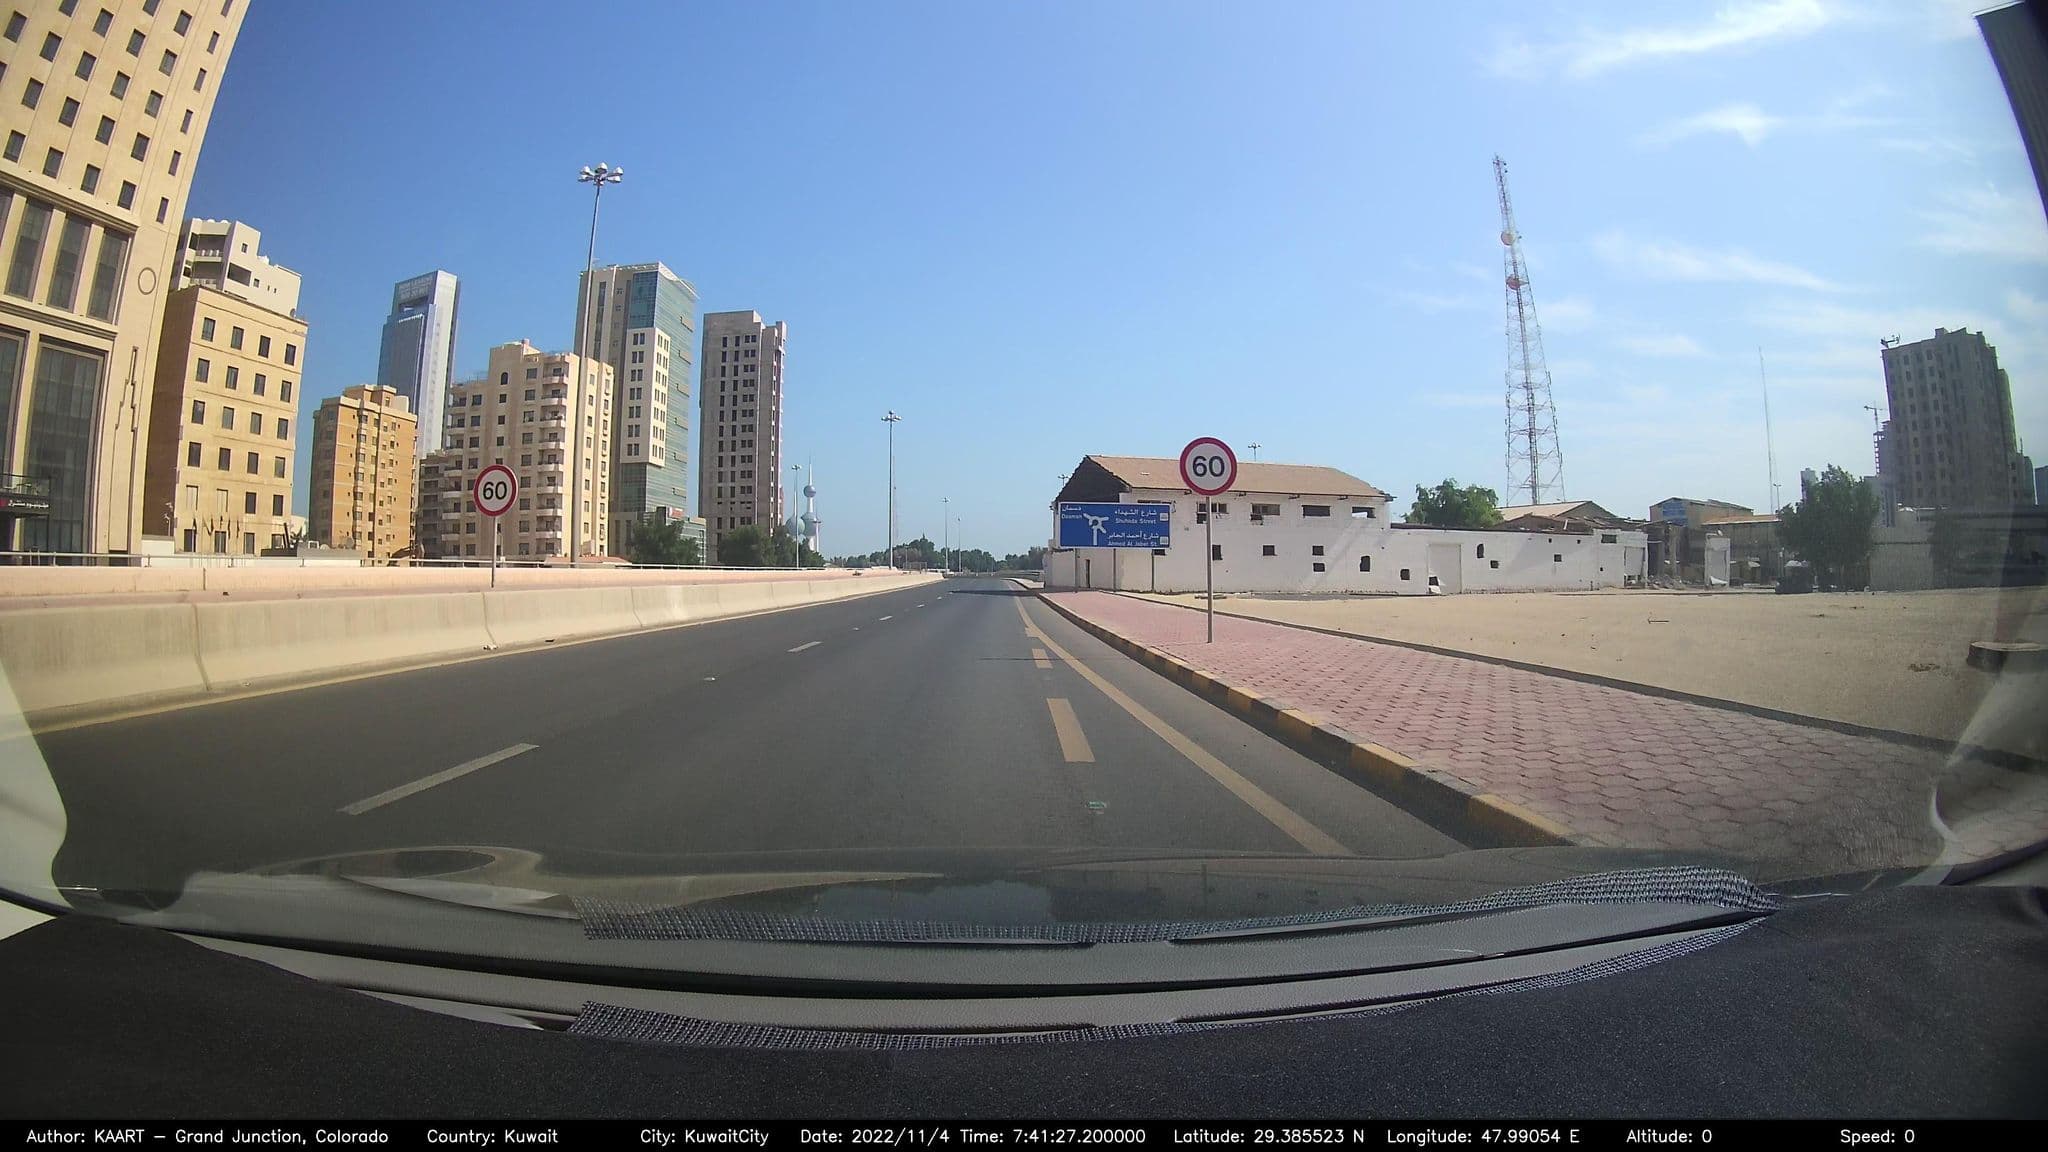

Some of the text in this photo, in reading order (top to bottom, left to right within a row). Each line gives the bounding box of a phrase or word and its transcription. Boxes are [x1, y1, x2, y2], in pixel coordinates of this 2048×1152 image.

[1193, 456, 1225, 477] 60
[483, 482, 507, 500] 60
[1114, 508, 1157, 516] شارع الشهداء
[1127, 530, 1142, 538] أحمد
[1143, 532, 1159, 540] شارع
